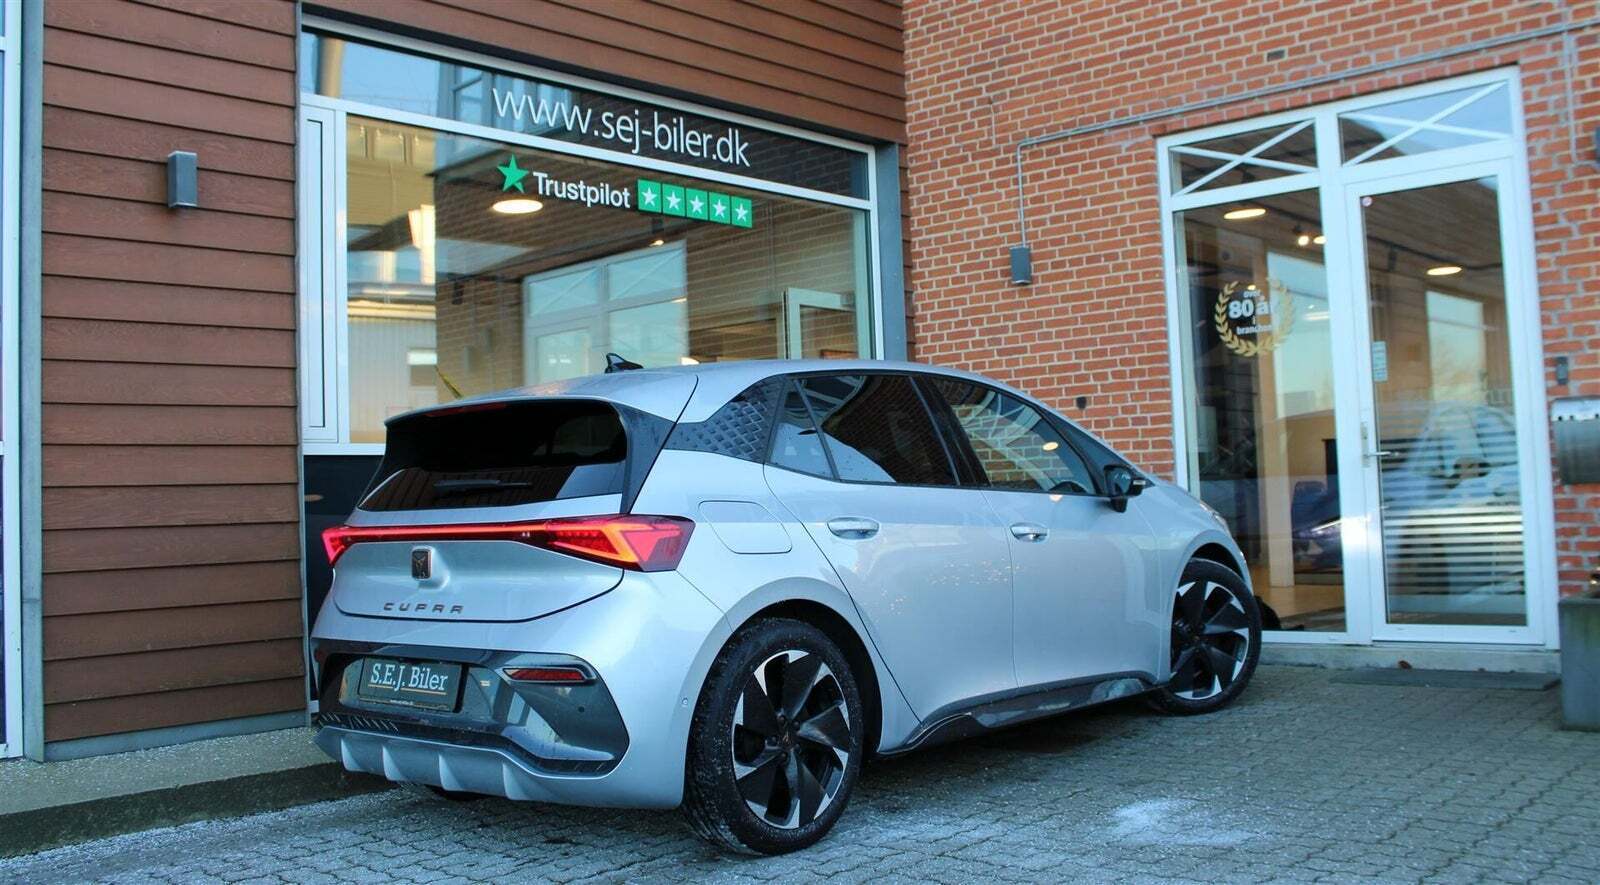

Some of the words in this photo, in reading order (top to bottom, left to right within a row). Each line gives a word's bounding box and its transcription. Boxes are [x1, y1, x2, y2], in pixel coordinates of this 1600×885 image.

[492, 87, 751, 167] www.sej-biler.dk
[532, 171, 631, 208] Trustpilot
[1228, 299, 1255, 319] 80
[383, 602, 464, 614] CUPRA
[370, 663, 406, 691] S.E.J.
[408, 667, 448, 691] Biler
